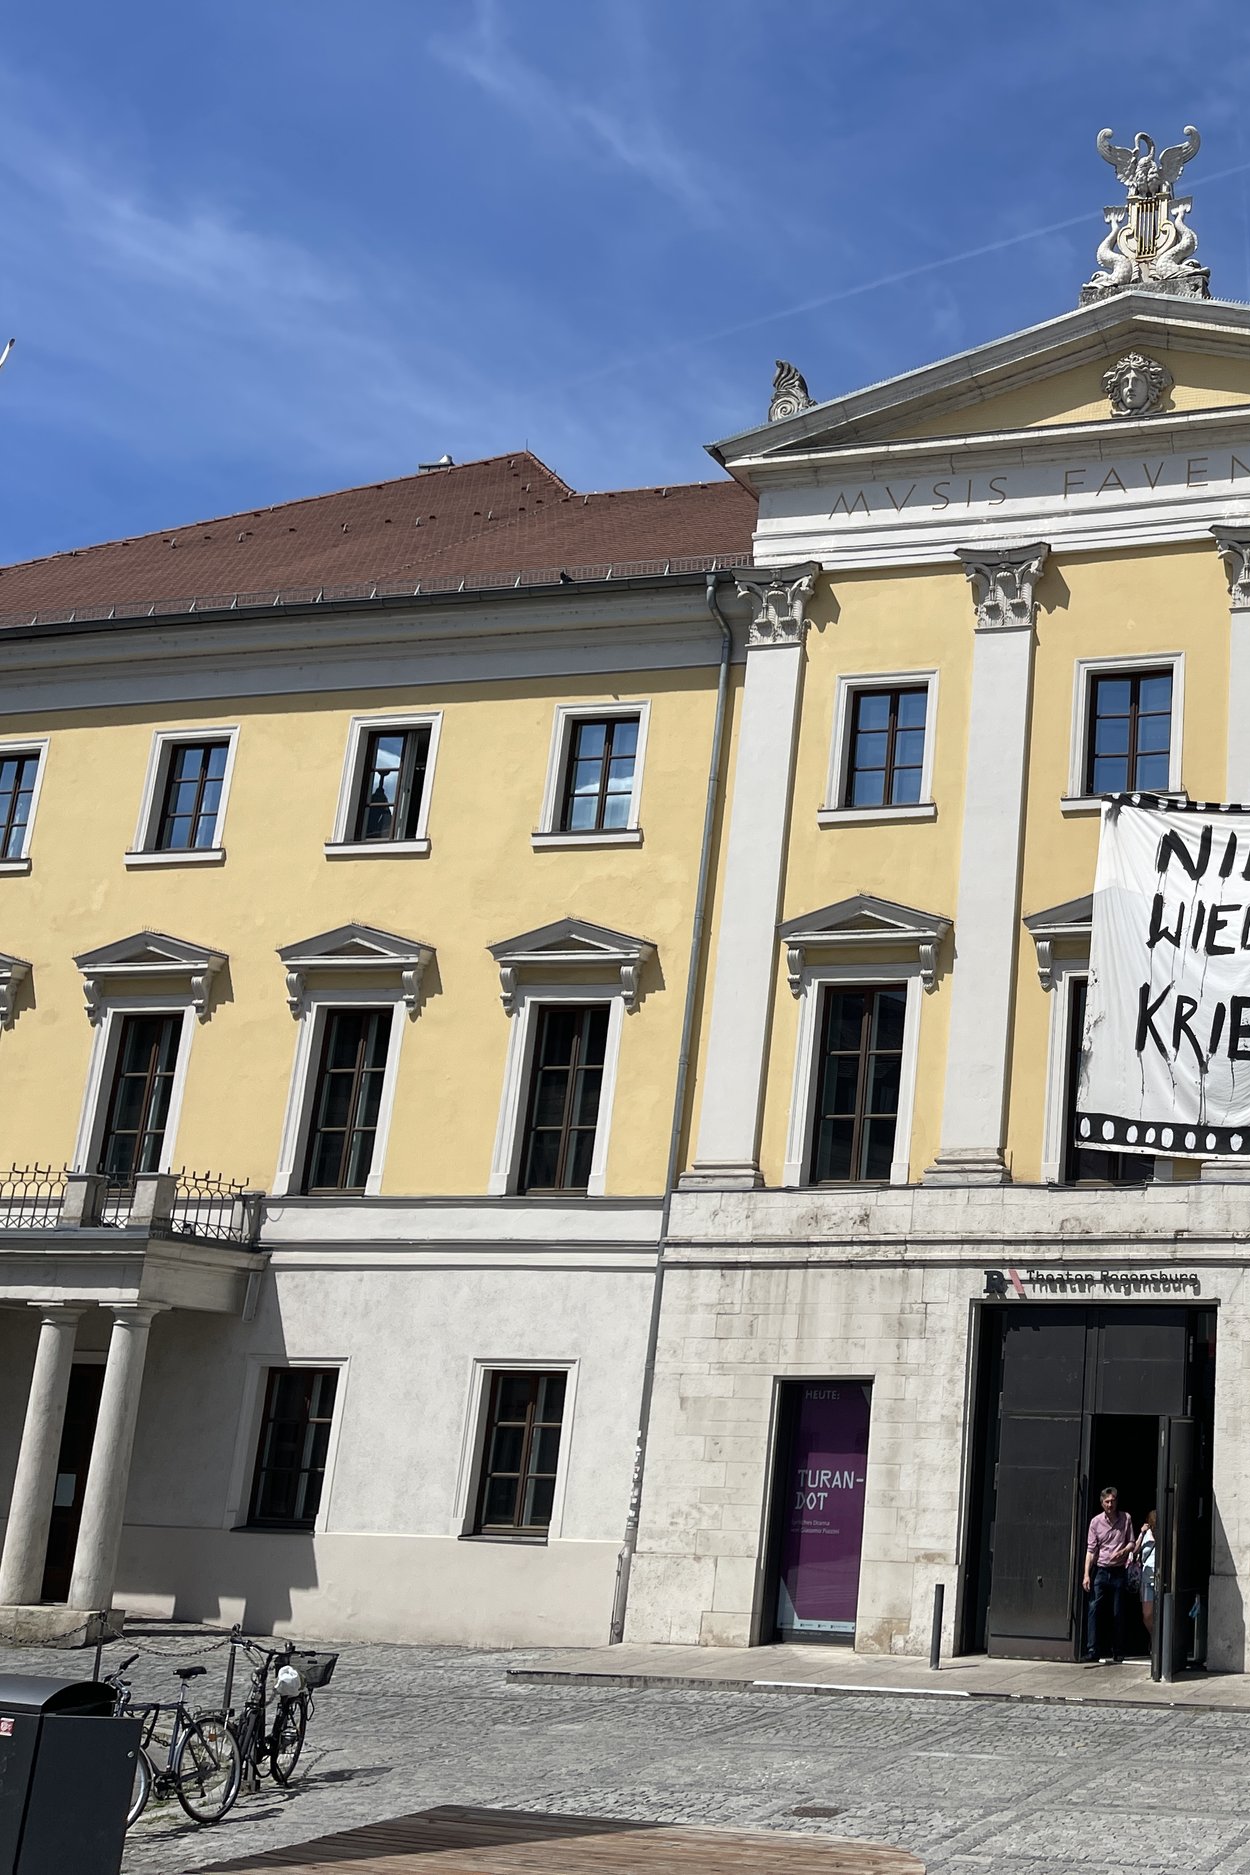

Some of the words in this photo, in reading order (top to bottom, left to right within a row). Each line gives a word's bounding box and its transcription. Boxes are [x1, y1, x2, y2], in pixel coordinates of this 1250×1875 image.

[828, 476, 1008, 520] MVSIS
[805, 1390, 840, 1400] HEUTE:
[798, 1469, 864, 1489] TURAN-
[795, 1491, 828, 1511] DOT
